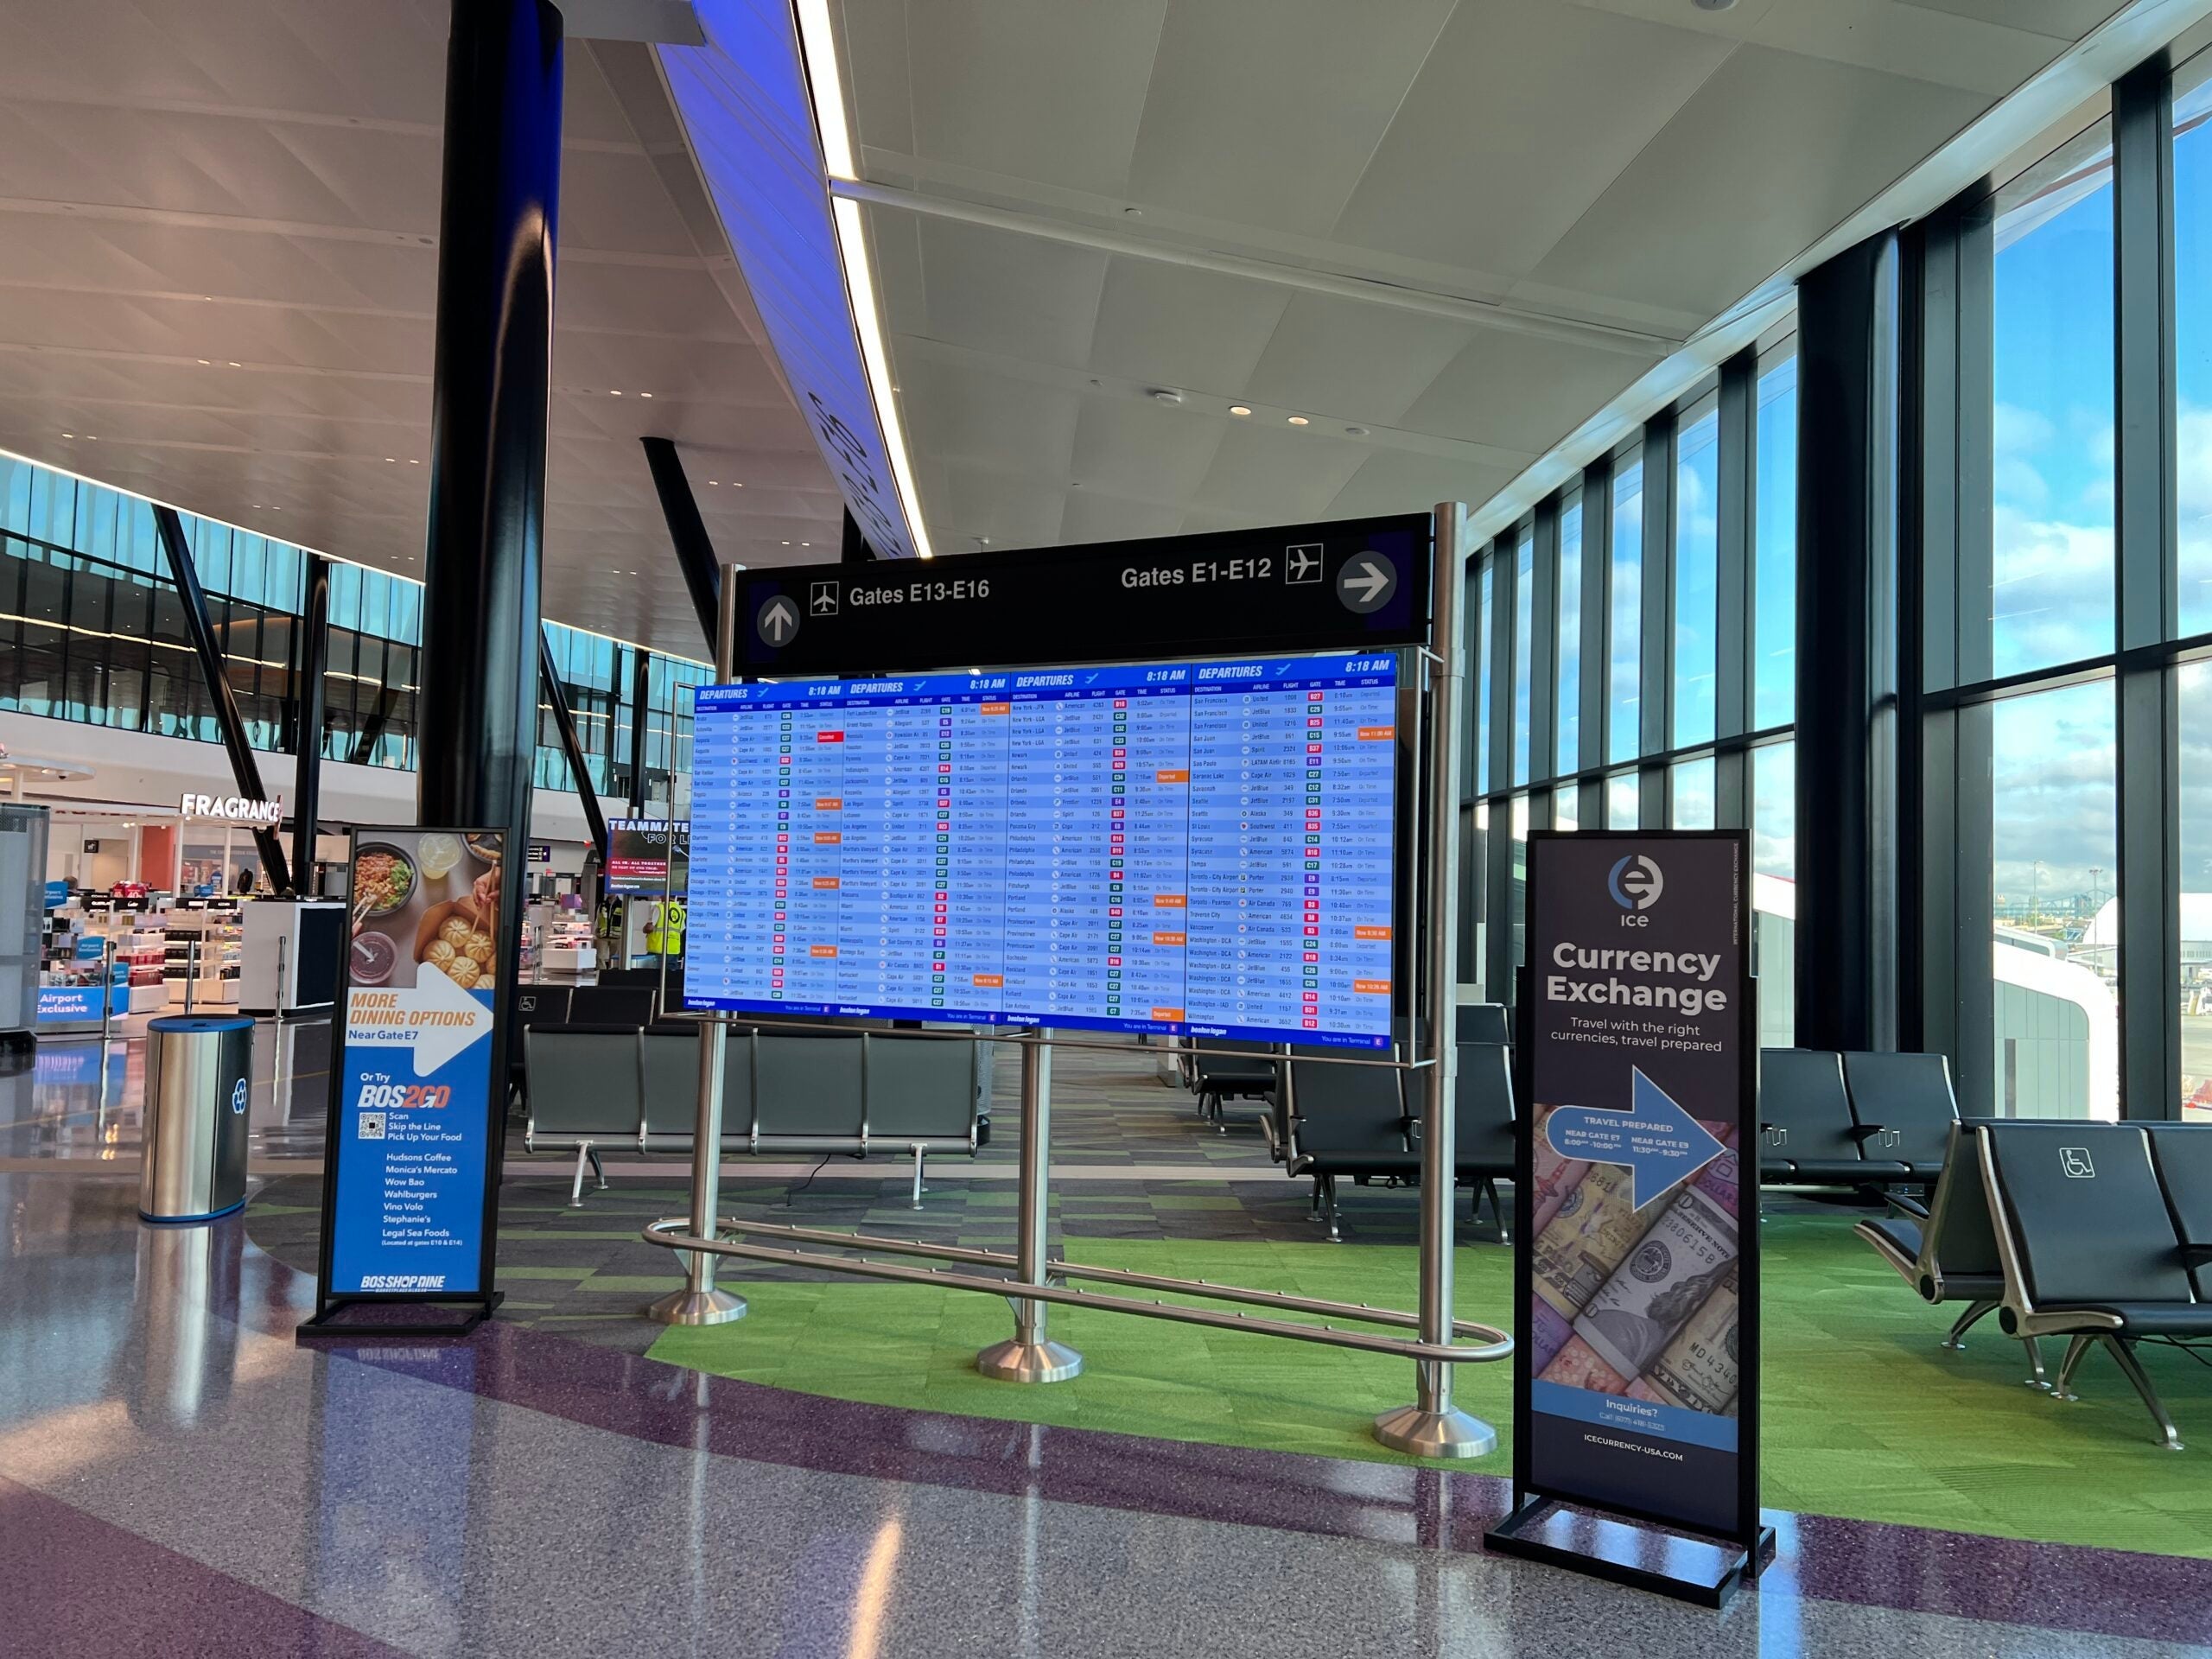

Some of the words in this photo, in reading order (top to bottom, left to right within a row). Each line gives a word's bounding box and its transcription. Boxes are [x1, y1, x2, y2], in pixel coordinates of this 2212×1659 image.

[1121, 565, 1184, 589] Gates
[1191, 558, 1271, 582] E1-E12
[850, 586, 905, 608] Gates
[911, 580, 989, 604] E13-E16
[1199, 666, 1262, 679] DEPARTURES
[1345, 661, 1369, 672] 8:18
[1372, 660, 1389, 671] AM
[1016, 675, 1073, 687] DEPARTURES
[1147, 671, 1167, 682] 8:18
[1170, 671, 1185, 679] AM
[809, 687, 826, 696] 8:18
[828, 686, 841, 695] AM
[850, 683, 904, 694] DEPARTURES
[970, 680, 988, 690] 8:18
[991, 679, 1006, 688] AM
[699, 690, 747, 700] DEPARTURES
[181, 793, 279, 821] FRAGRANCE
[1554, 942, 1721, 982] Currency
[40, 994, 83, 1003] Airport
[351, 994, 398, 1007] MORE
[1548, 976, 1726, 1016] Exchange
[350, 1010, 405, 1025] DINING
[409, 1012, 475, 1026] OPTIONS
[1571, 1017, 1607, 1029] Travel
[1611, 1020, 1638, 1031] with
[1643, 1022, 1664, 1033] the
[1668, 1024, 1700, 1037] right
[349, 1030, 376, 1039] Near
[378, 1031, 404, 1039] Gate
[404, 1031, 418, 1039] E7
[1551, 1032, 1618, 1046] currencies,
[1622, 1035, 1656, 1047] travel
[1661, 1039, 1721, 1052] prepared
[375, 1073, 390, 1083] Try
[358, 1085, 450, 1108] BOS2GO
[1584, 1116, 1620, 1128] TRAVEL
[1622, 1121, 1673, 1133] PREPARED
[1566, 1129, 1586, 1138] NEAR
[1588, 1132, 1609, 1141] GATE
[1631, 1136, 1654, 1145] NEAR
[1656, 1138, 1677, 1147] GATE
[385, 1191, 437, 1199] Wahlburgers
[1606, 1399, 1657, 1417] Inquiries?
[1584, 1433, 1683, 1462] ICECURRENCY-USA.COM
